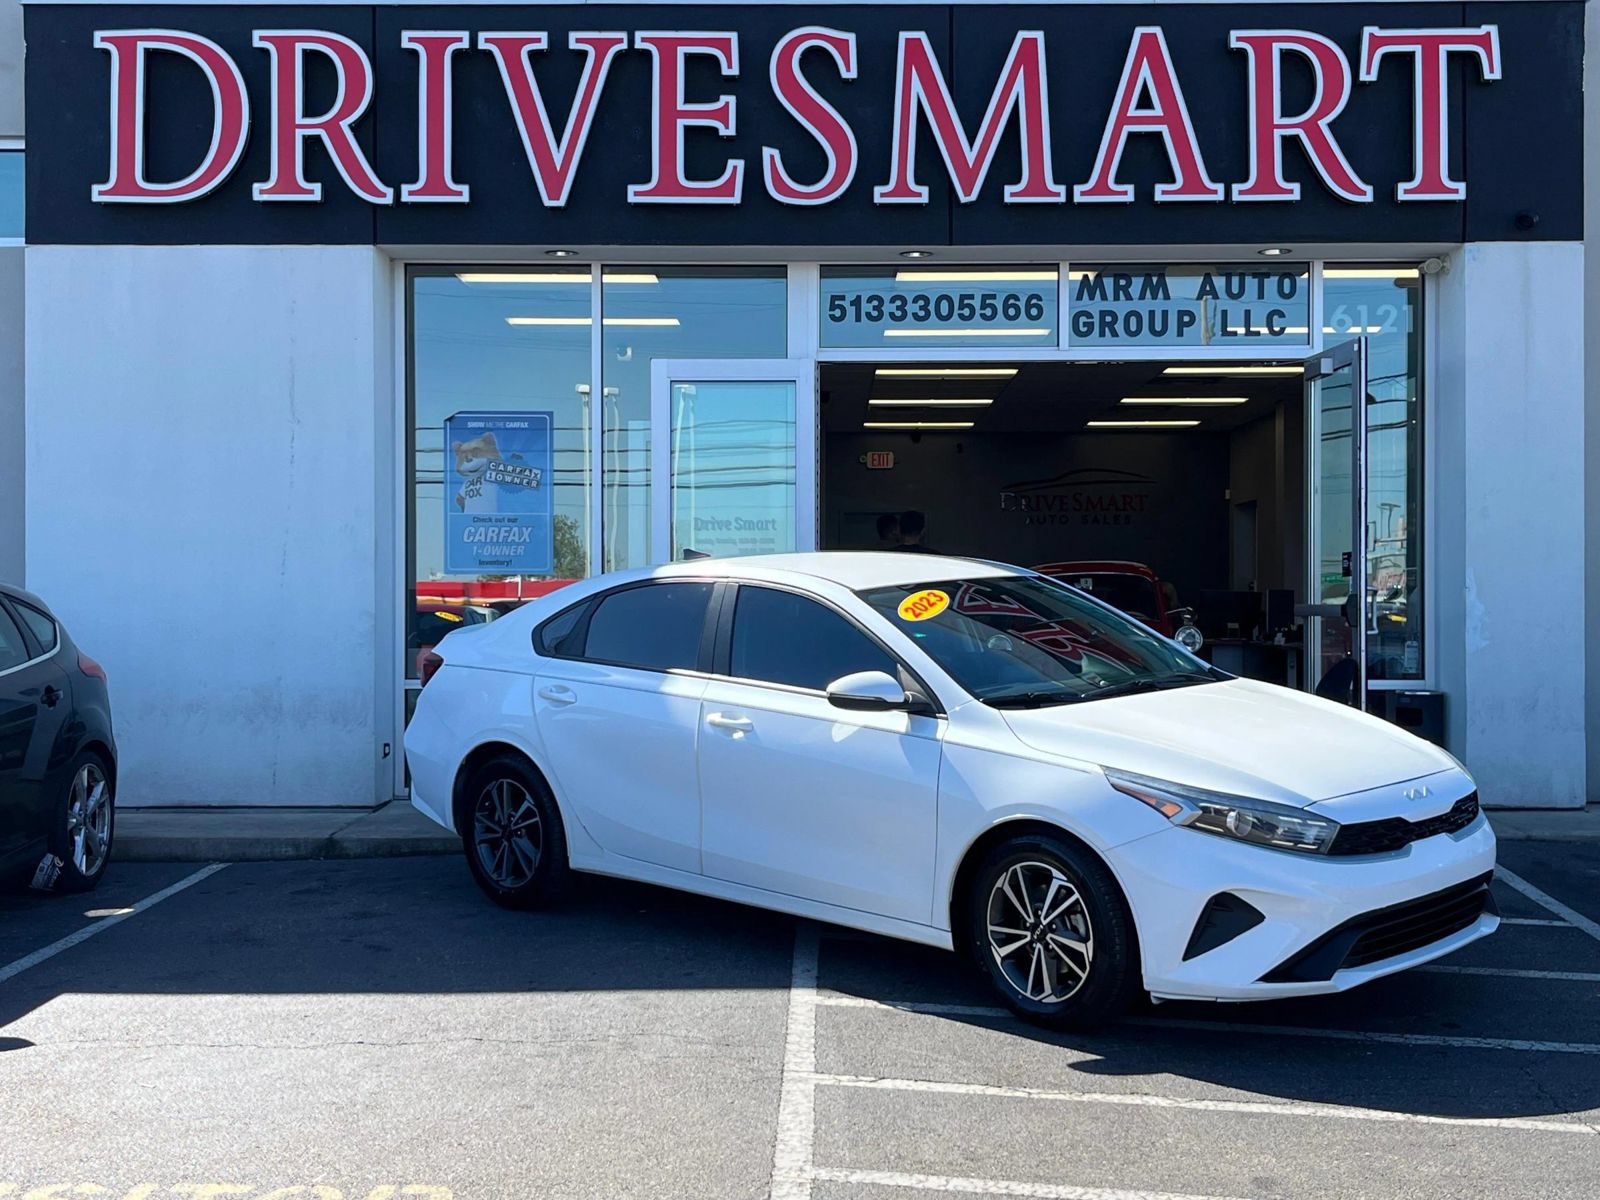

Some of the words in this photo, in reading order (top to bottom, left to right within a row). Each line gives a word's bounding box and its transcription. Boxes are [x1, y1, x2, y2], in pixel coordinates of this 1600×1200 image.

[91, 25, 1503, 208] DRIVESMART
[1075, 272, 1171, 301] MRM
[1196, 271, 1297, 300] AUTO
[828, 293, 1044, 323] 5133305566
[1071, 309, 1196, 338] GROUP
[1220, 309, 1286, 337] LLC
[1330, 304, 1414, 333] 6121
[871, 453, 890, 466] EXIT
[489, 462, 541, 480] CARFAX
[496, 473, 539, 488] OWNER
[464, 487, 483, 499] FOX
[693, 516, 733, 532] Drive
[734, 516, 777, 532] Smart
[1024, 514, 1070, 526] AUTO
[1081, 514, 1132, 526] SALES
[463, 526, 532, 543] CARFAX
[472, 545, 525, 556] 1-OWNER
[904, 591, 945, 619] 2023
